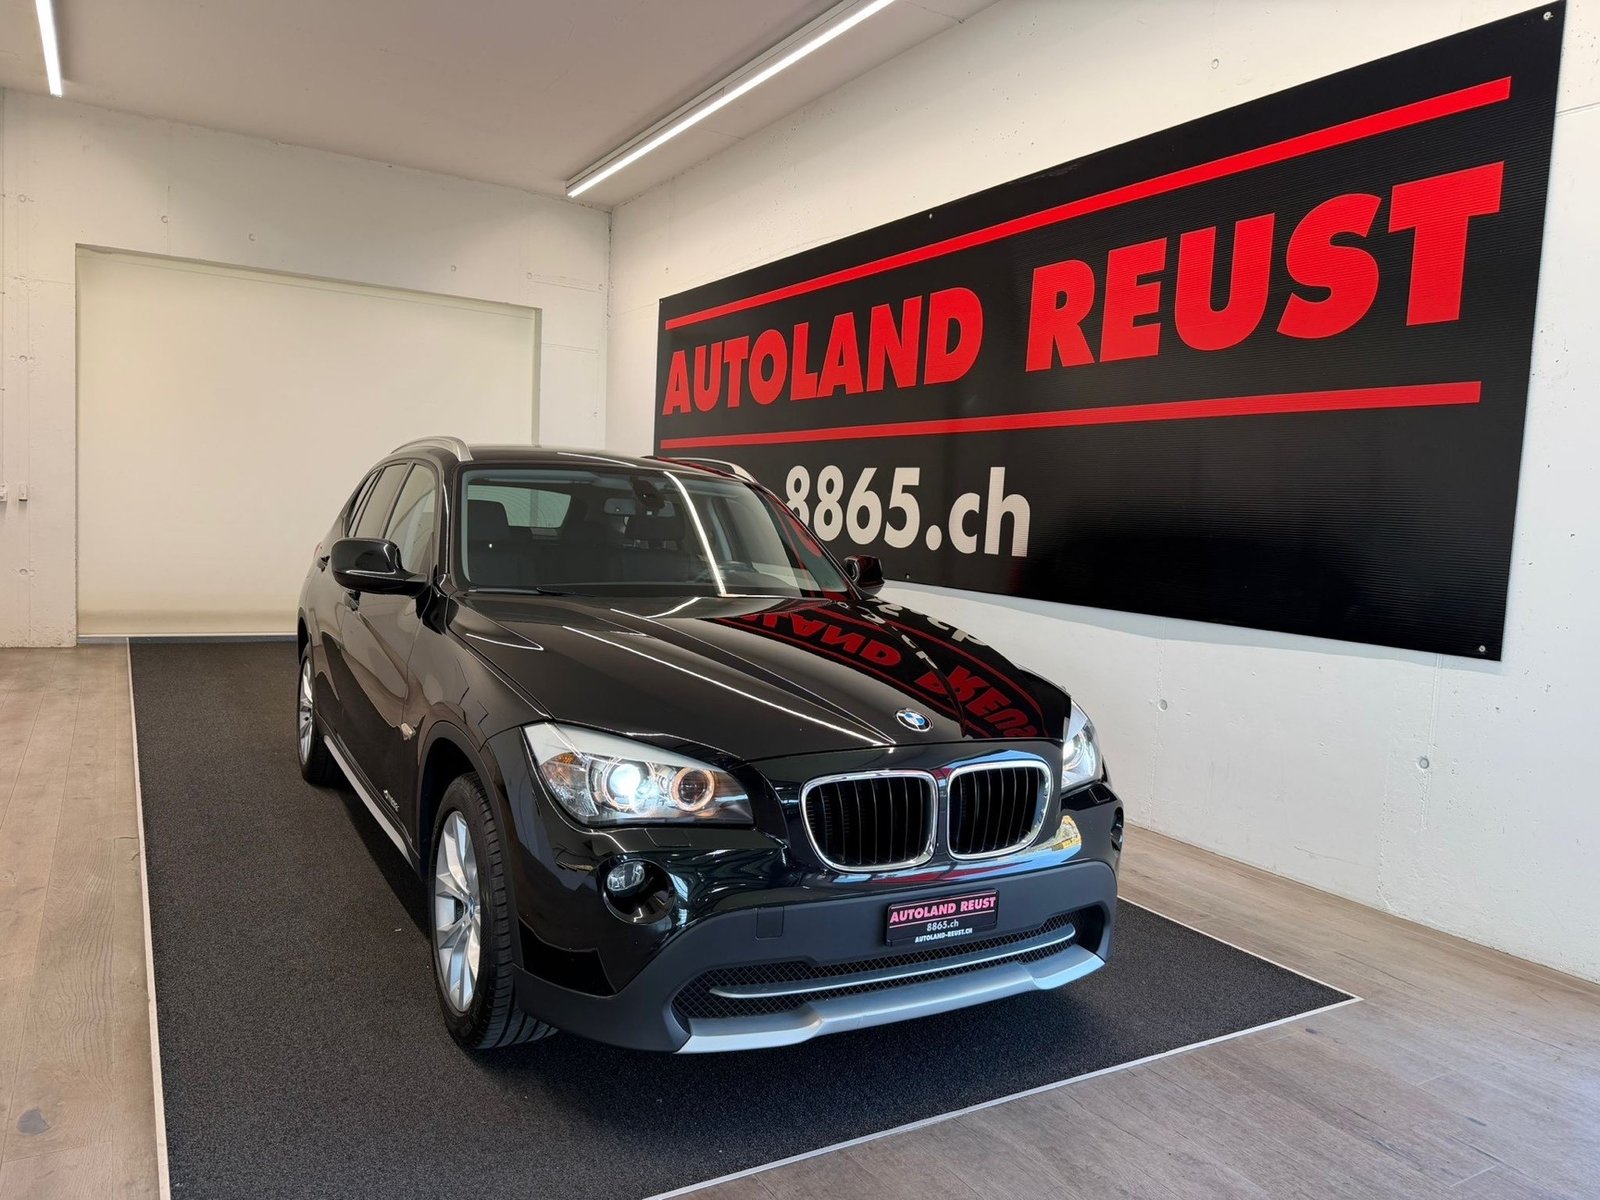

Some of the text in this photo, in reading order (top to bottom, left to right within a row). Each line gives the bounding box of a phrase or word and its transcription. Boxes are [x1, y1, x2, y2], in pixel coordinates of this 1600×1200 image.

[663, 160, 1505, 415] AUTOLAND REUST
[785, 464, 1031, 558] 8865.ch
[890, 897, 996, 923] AUTOLAND REUST
[914, 927, 973, 943] AUTOLAND-REUST.CH
[926, 919, 959, 932] 8865.ch
